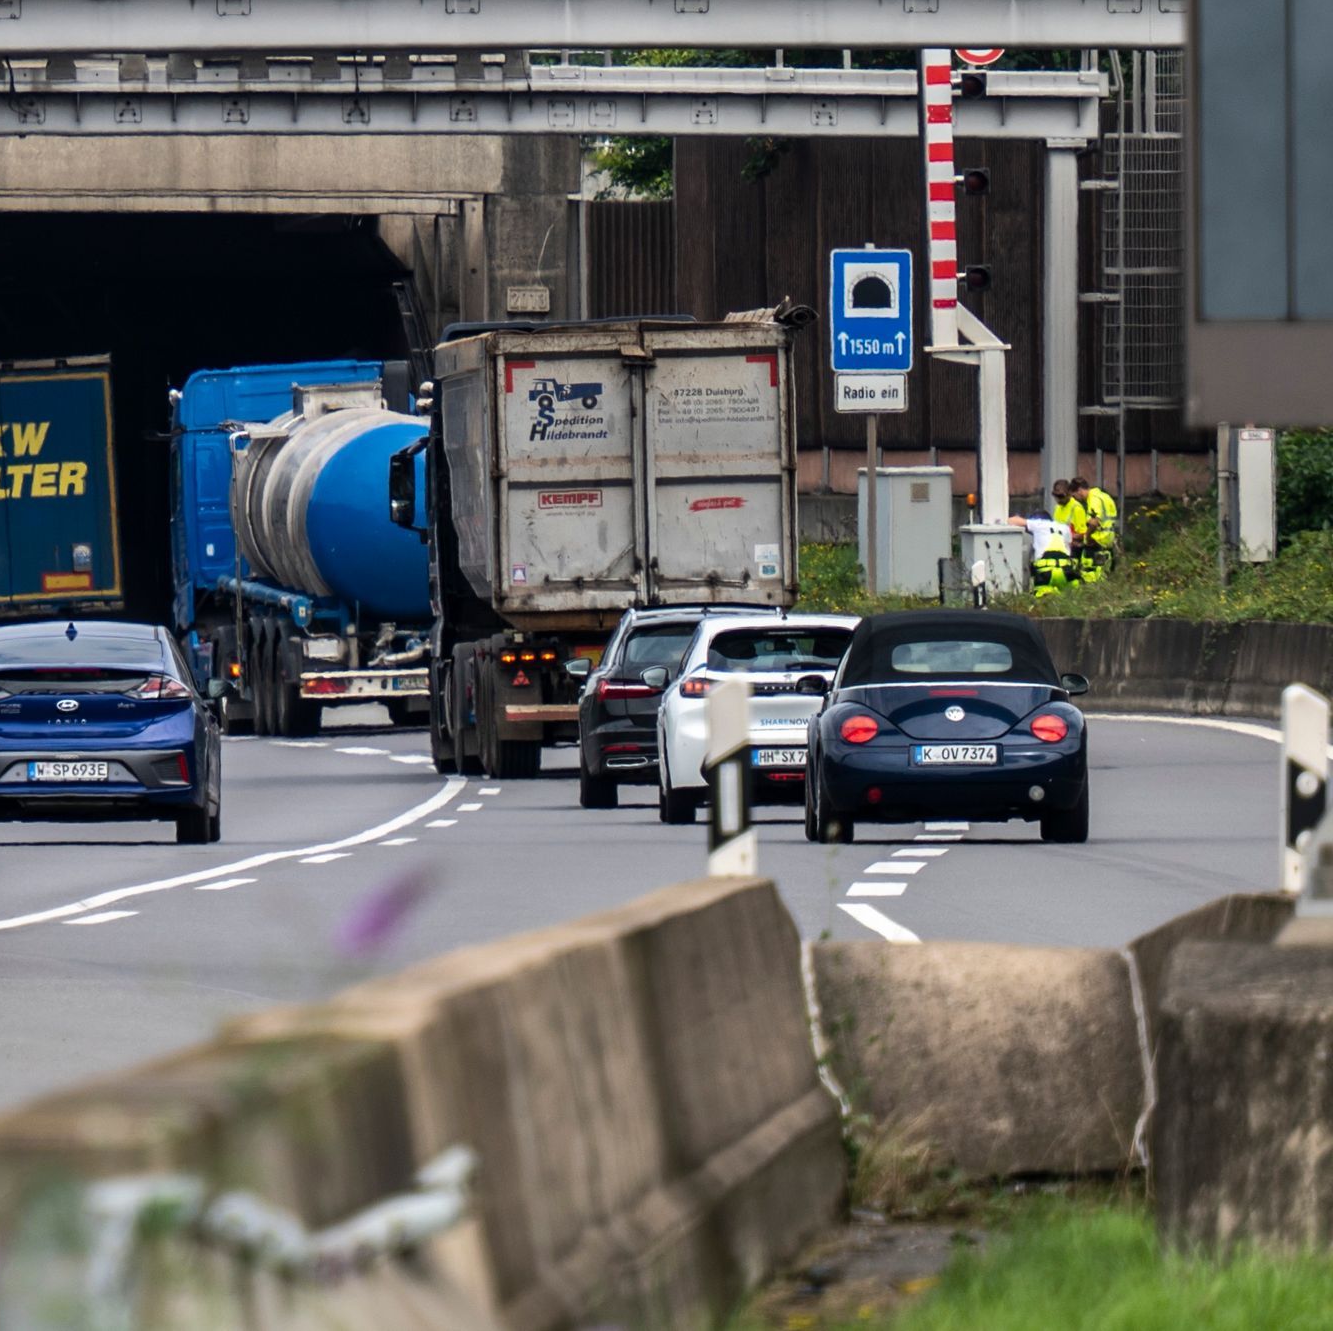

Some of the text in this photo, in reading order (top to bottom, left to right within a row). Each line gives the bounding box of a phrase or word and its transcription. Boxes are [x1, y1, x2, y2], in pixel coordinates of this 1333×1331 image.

[850, 339, 895, 355] 1550 m
[844, 385, 899, 399] Radio ein
[539, 406, 604, 427] Spedition
[530, 423, 608, 441] Hildebrandt
[542, 493, 598, 505] KEMPF
[759, 751, 774, 762] HH
[781, 751, 796, 762] SX
[924, 747, 994, 760] K OV 7374
[37, 764, 106, 776] W SP 693E
